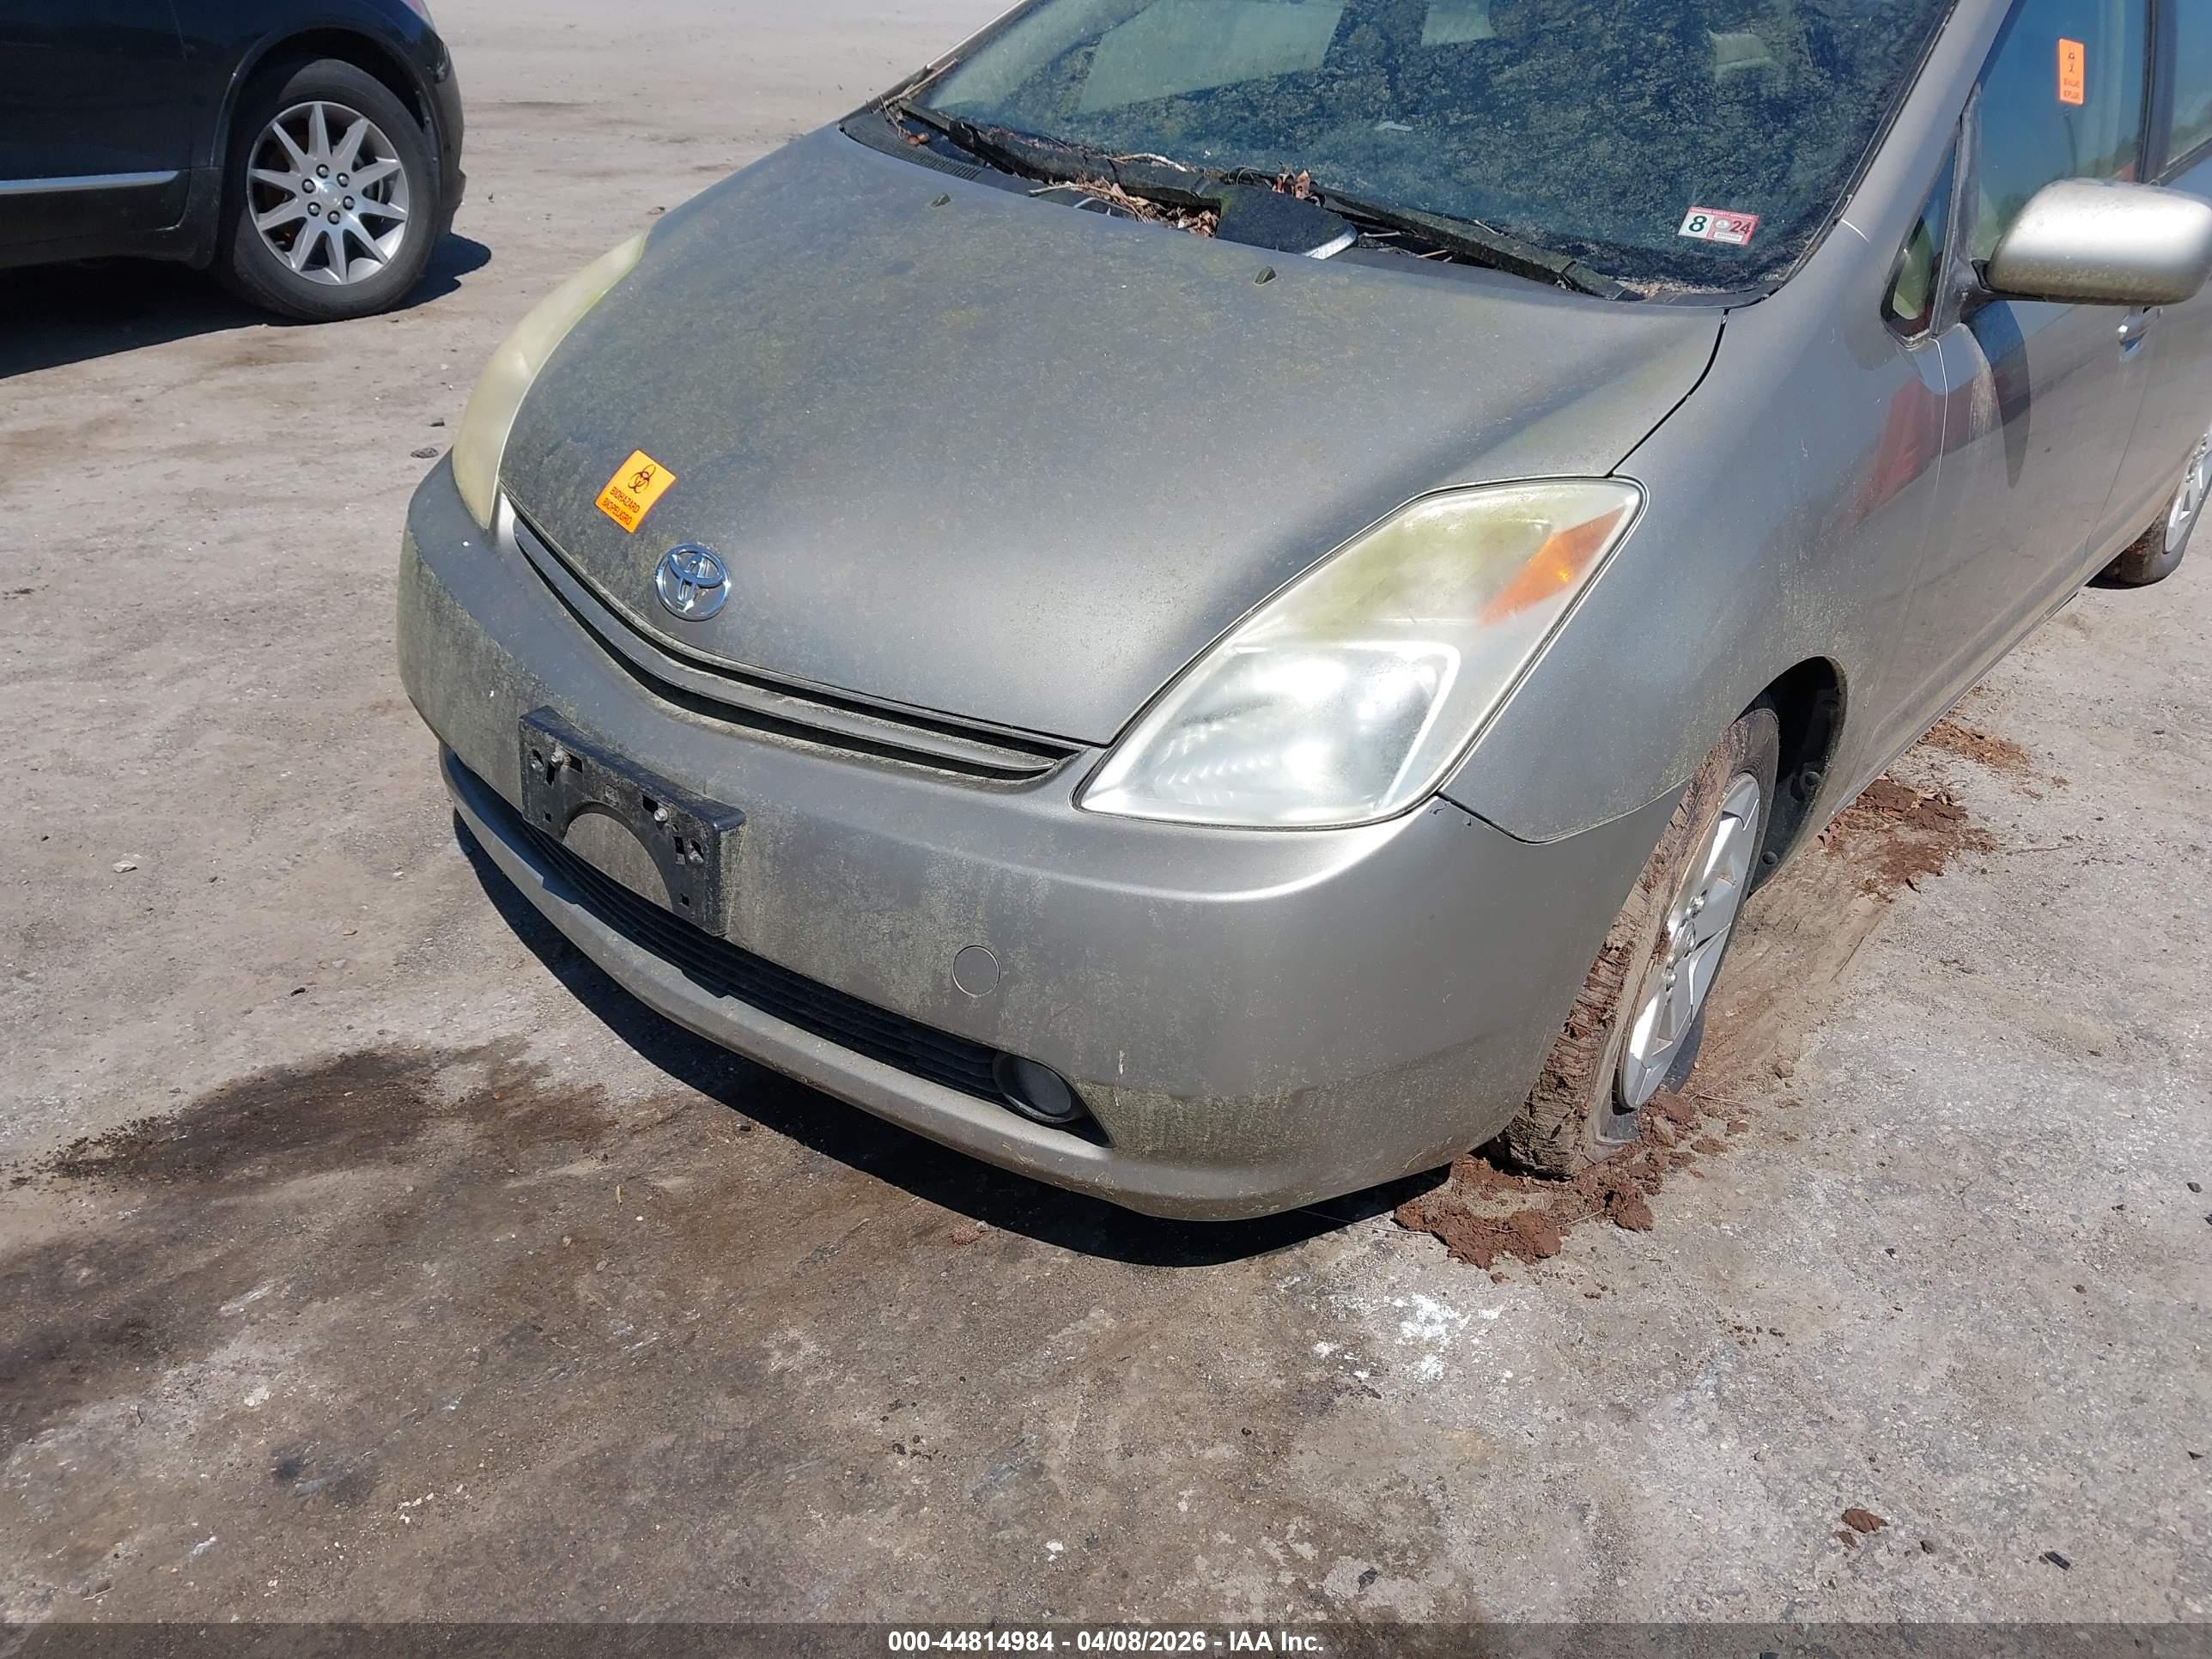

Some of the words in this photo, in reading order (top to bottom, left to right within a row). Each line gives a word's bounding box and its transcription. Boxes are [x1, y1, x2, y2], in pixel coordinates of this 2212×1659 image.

[1688, 215, 1708, 233] 8
[1729, 220, 1752, 234] 24
[602, 497, 633, 526] BIOPELIGRO
[610, 486, 641, 514] BIOHAZARD
